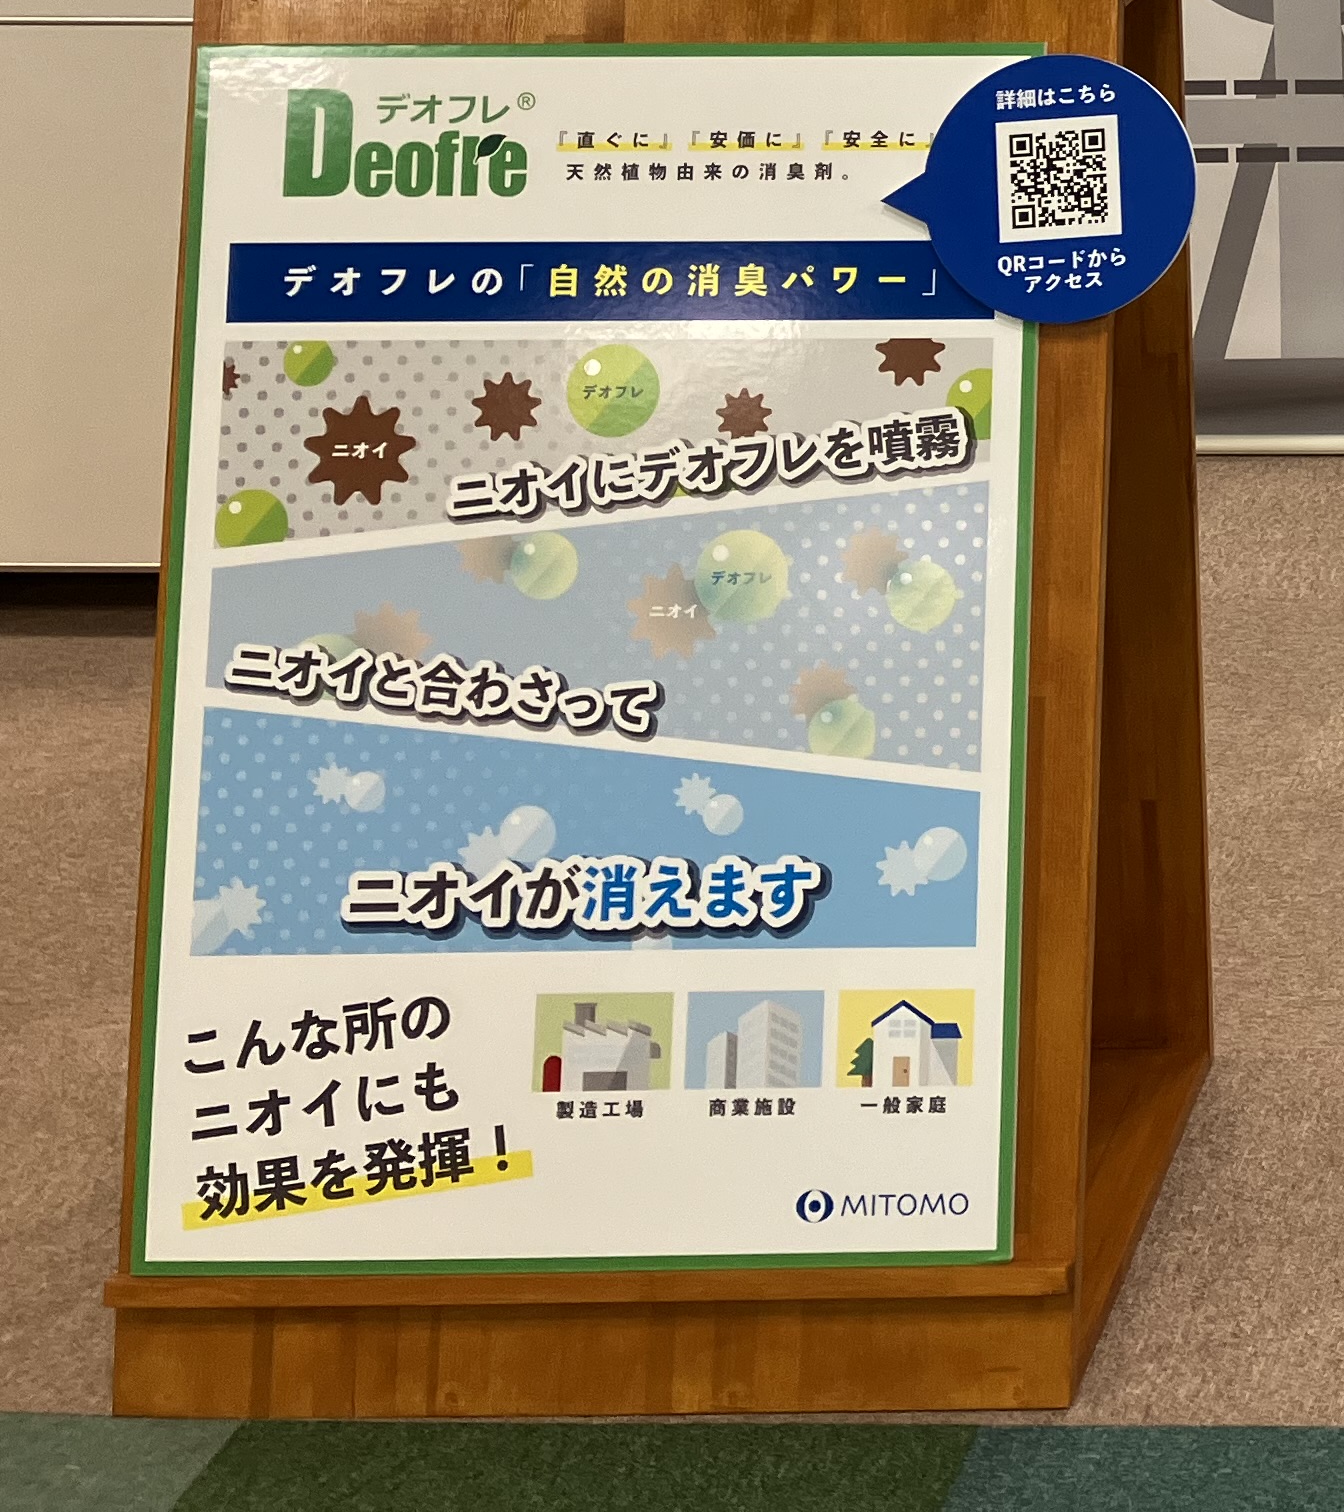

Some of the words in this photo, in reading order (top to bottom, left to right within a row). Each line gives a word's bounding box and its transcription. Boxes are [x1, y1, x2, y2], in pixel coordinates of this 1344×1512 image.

[994, 83, 1117, 111] 詳細はこちら
[281, 88, 529, 198] Deofre
[565, 162, 853, 182] 天然植物由来の消臭剤。
[997, 247, 1127, 278] QRコードから
[1024, 270, 1104, 294] アクセス
[582, 384, 644, 400] デオフレ
[330, 441, 391, 460] ニオイ
[450, 413, 963, 512] ニオイにデオフレを噴霧
[710, 570, 772, 588] デオフレ
[648, 602, 698, 620] ニオイ
[230, 649, 657, 733] ニオイと合わさって
[348, 862, 814, 925] ニオイが消えます
[182, 994, 452, 1075] こんな所の
[189, 1061, 460, 1142] ニオイにも
[555, 1100, 645, 1120] 製造工場
[708, 1096, 797, 1118] 商業施設
[859, 1094, 948, 1116] 一般家庭
[841, 1193, 970, 1218] MITOMO
